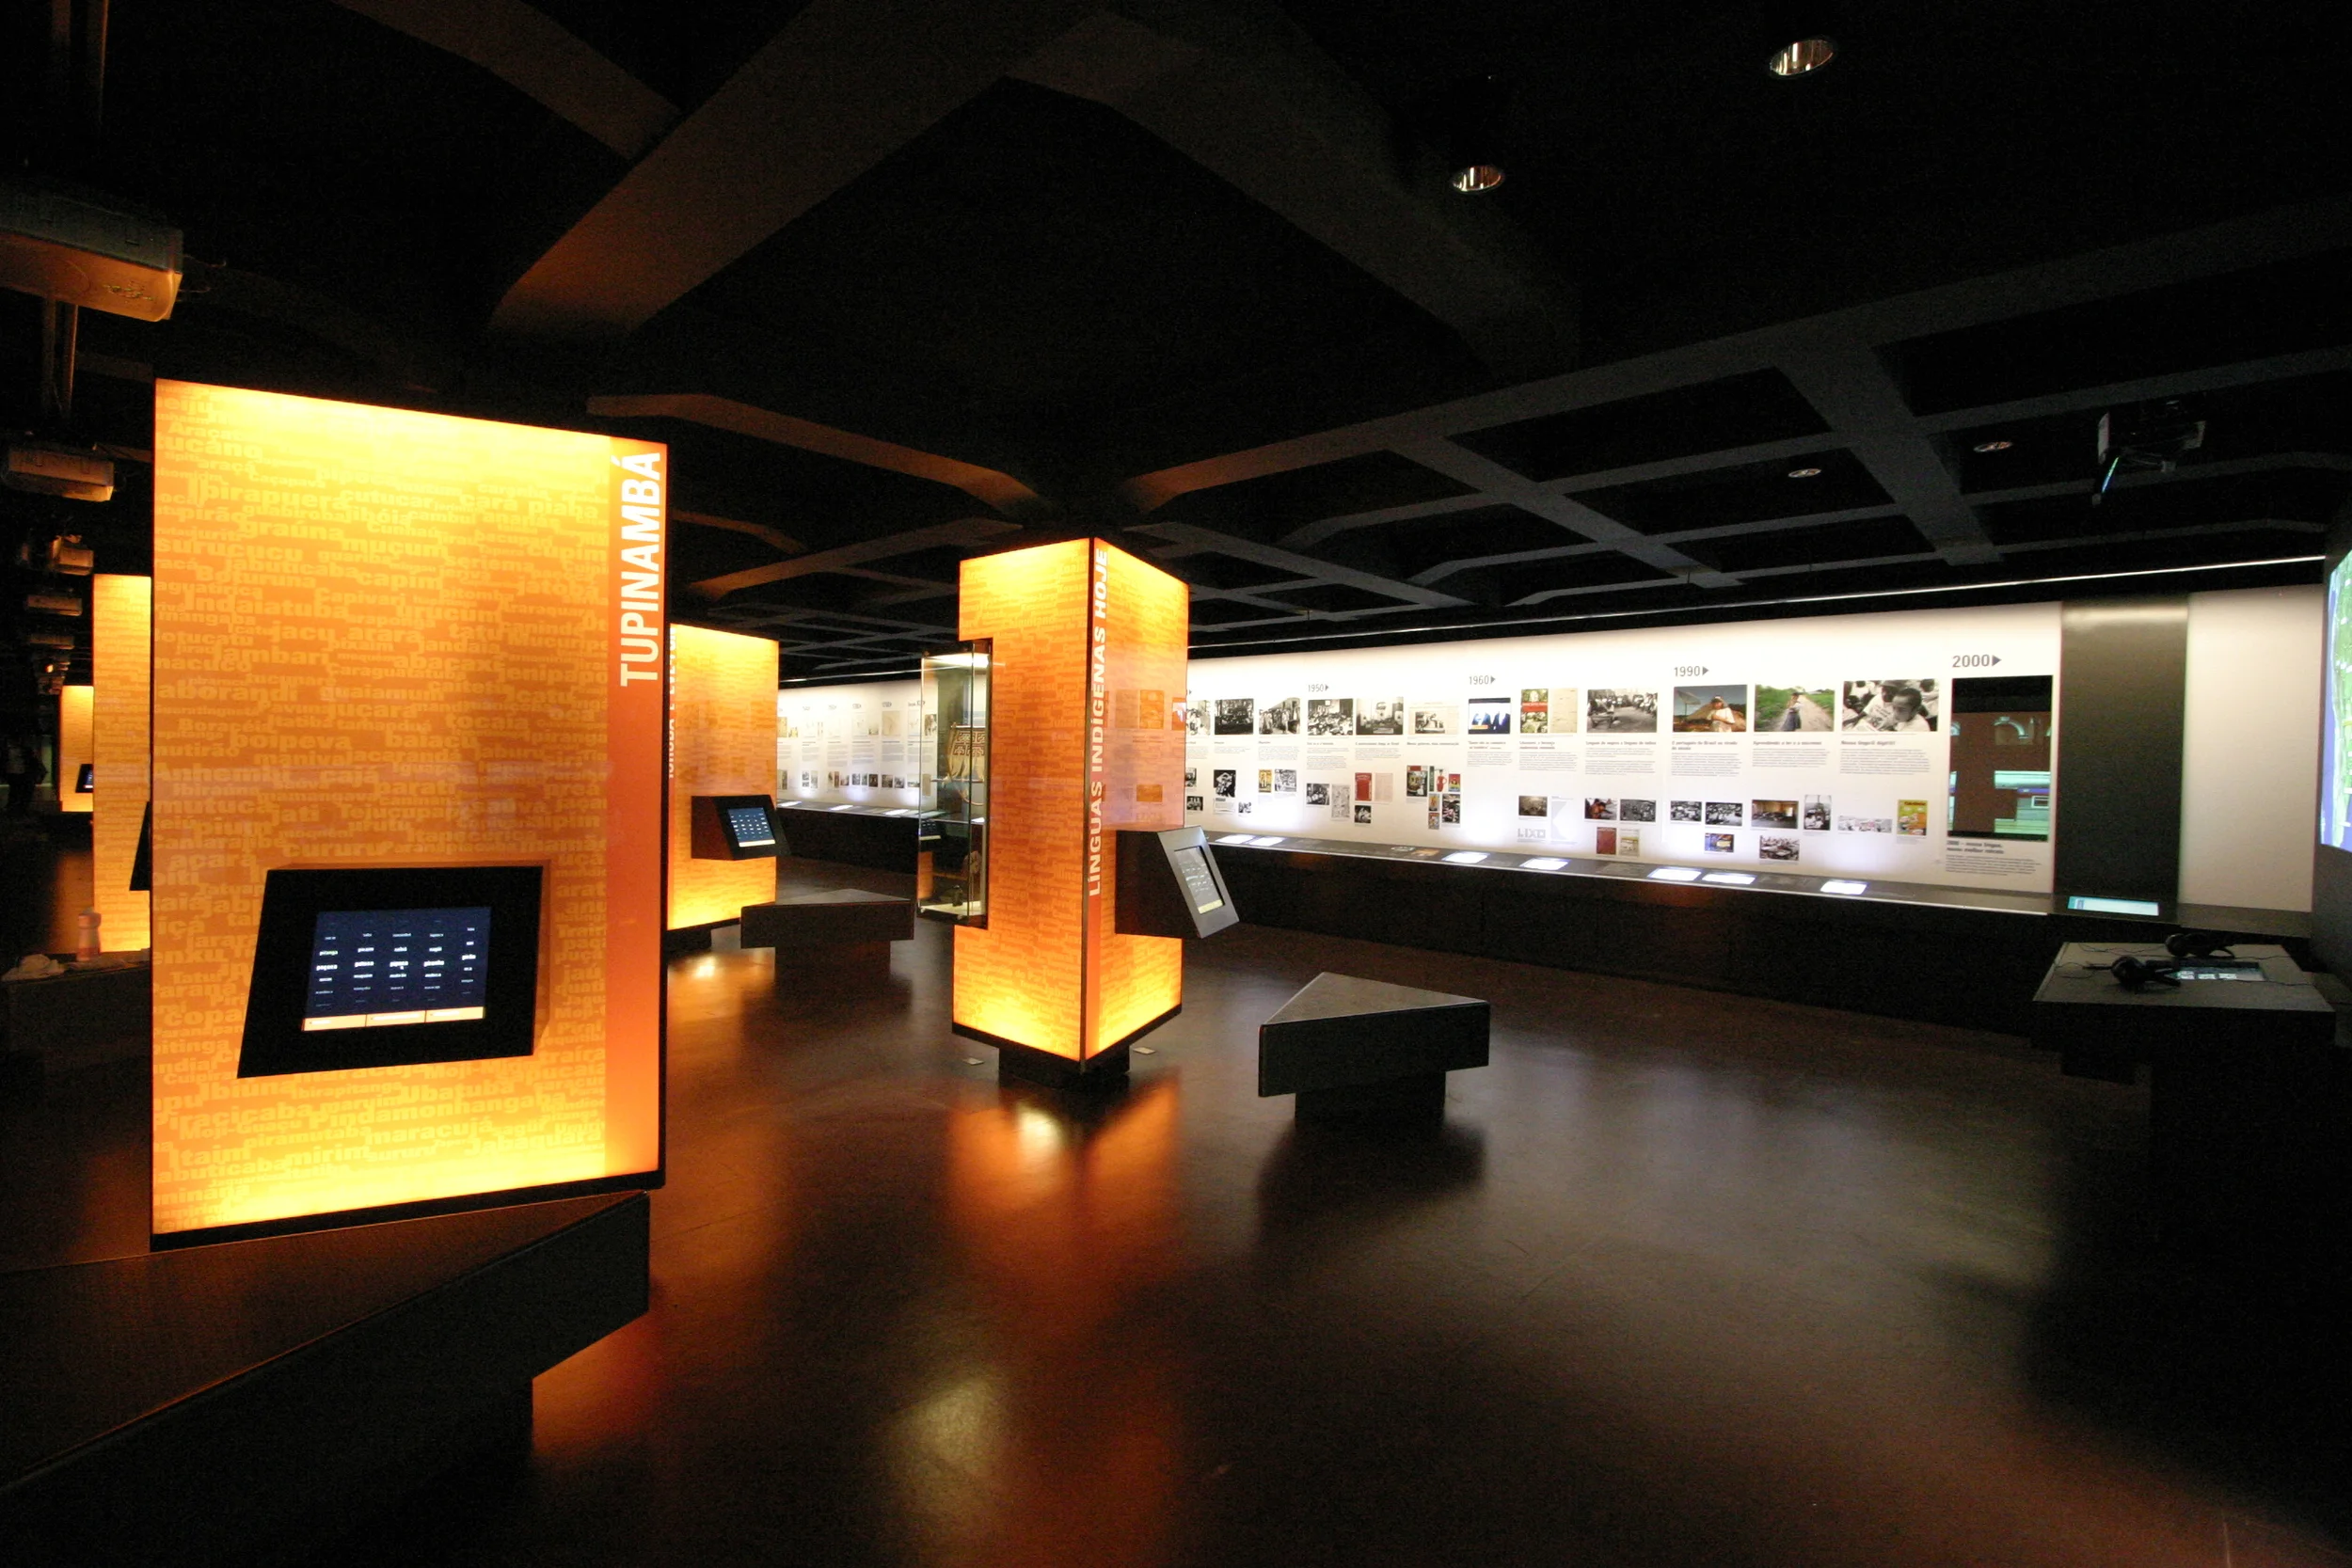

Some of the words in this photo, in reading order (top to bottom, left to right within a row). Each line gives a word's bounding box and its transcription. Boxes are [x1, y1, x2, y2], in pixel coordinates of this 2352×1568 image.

[340, 489, 435, 510] cutucar
[612, 452, 660, 687] TUPINAMBÁ
[356, 570, 443, 592] capim
[1093, 548, 1109, 620] HOJE
[1674, 666, 1700, 677] 1990
[1952, 654, 1990, 668] 2000
[1308, 684, 1325, 692] 1950
[1469, 675, 1489, 685] 1960
[1090, 626, 1107, 772] INDÍGENAS
[1089, 782, 1104, 896] LÍNGUAS
